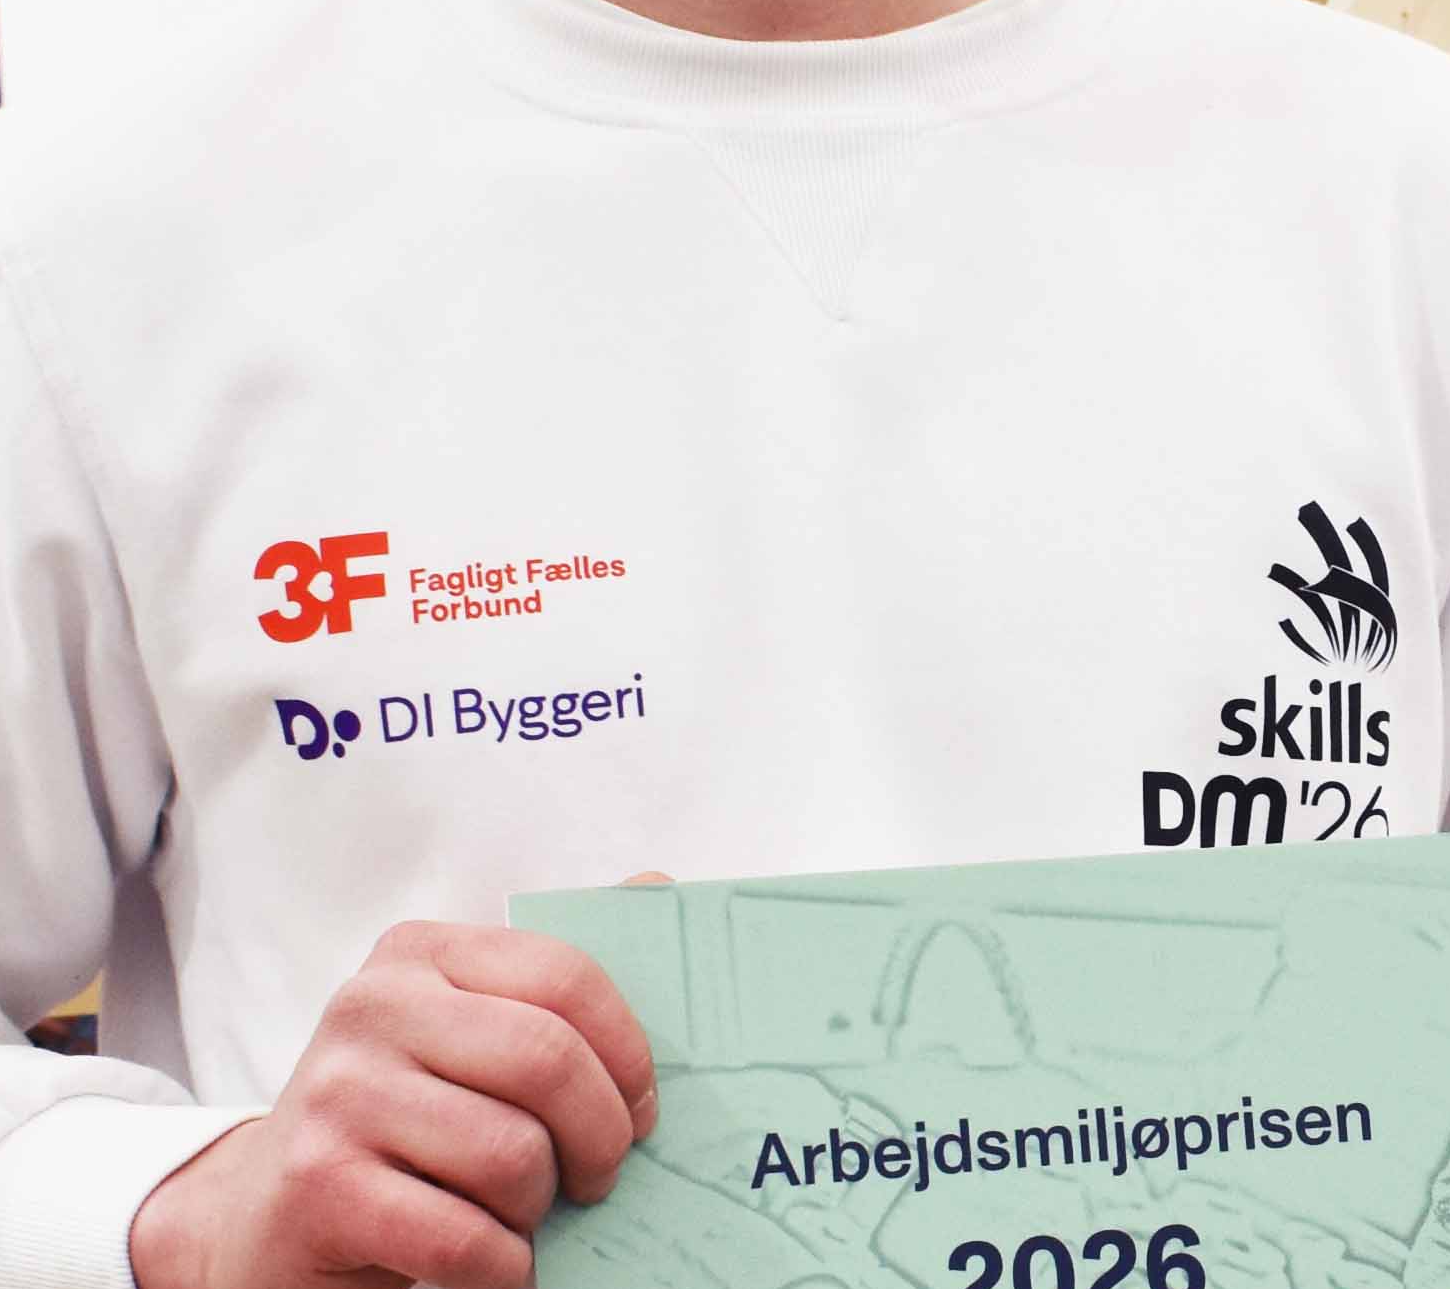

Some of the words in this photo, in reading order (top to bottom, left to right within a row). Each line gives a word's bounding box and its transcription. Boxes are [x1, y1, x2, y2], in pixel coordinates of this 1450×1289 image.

[254, 531, 389, 644] 3F
[410, 563, 517, 595] Fagligt
[526, 556, 626, 583] Fælles
[411, 589, 542, 623] Forbund
[379, 693, 434, 743] DI
[452, 673, 645, 743] Byggeri
[1218, 674, 1390, 767] skills
[751, 1097, 1372, 1191] Arbejdsmiljøprisen
